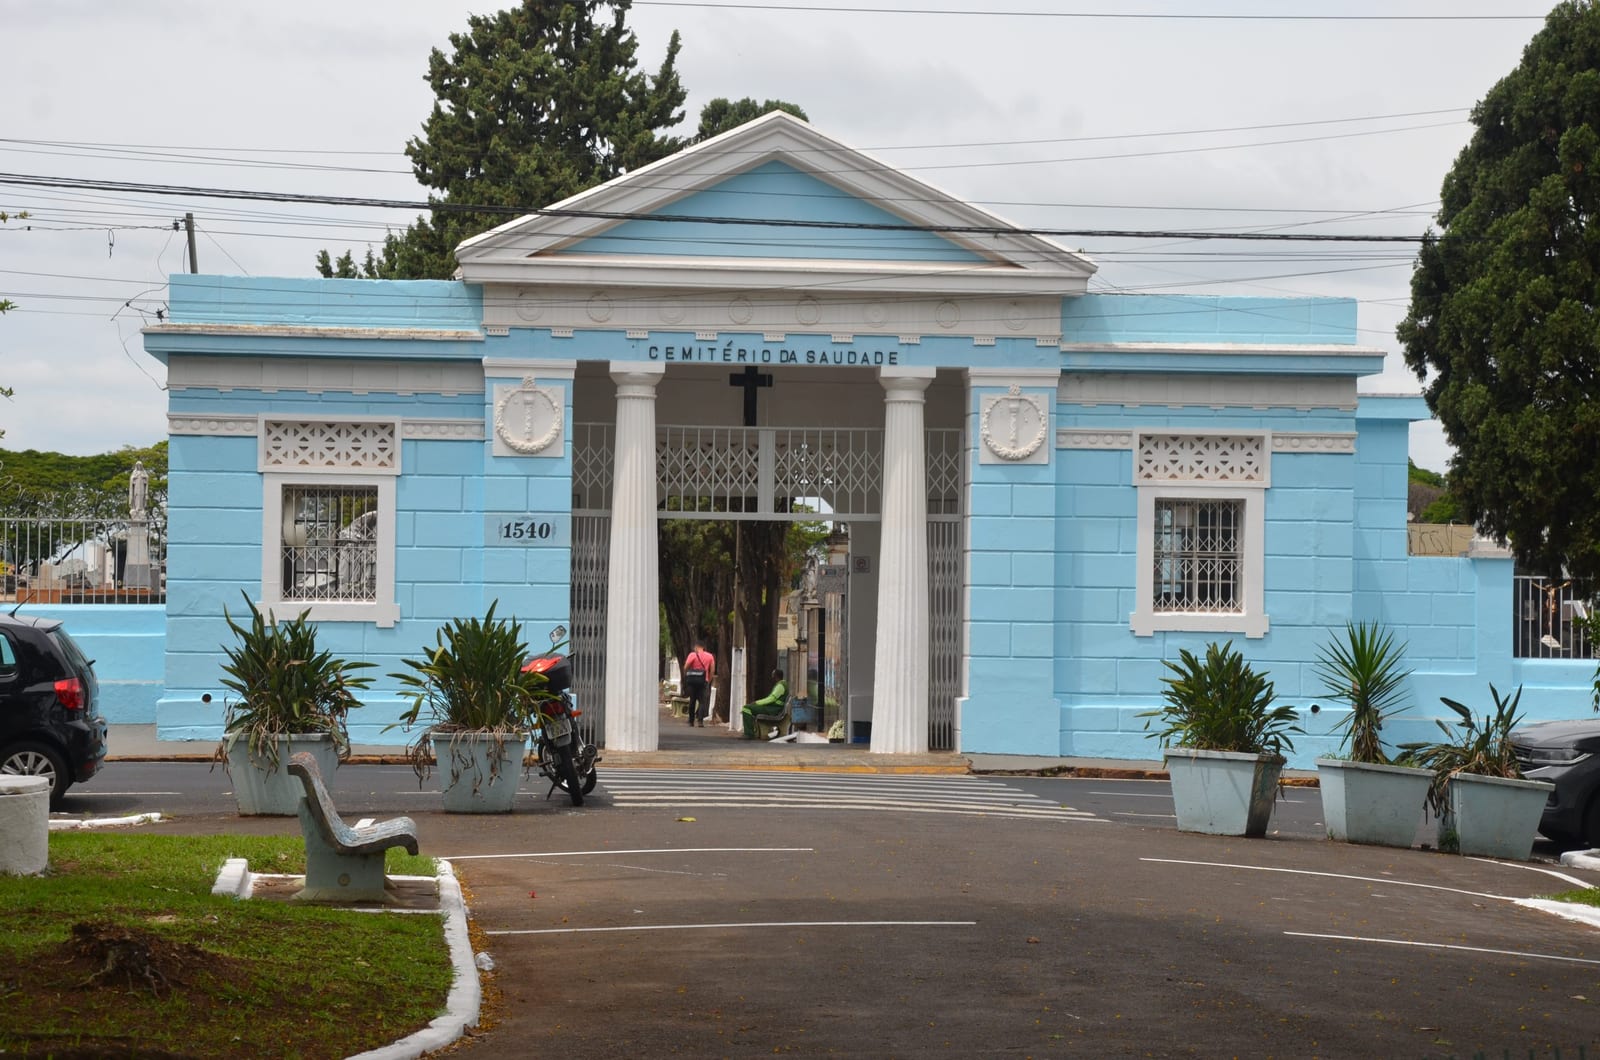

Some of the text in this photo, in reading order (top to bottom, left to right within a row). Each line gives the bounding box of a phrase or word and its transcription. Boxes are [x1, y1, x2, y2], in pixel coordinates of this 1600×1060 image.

[648, 340, 898, 366] CEMITÉRIO DA SAUDADE
[503, 522, 551, 539] 1540
